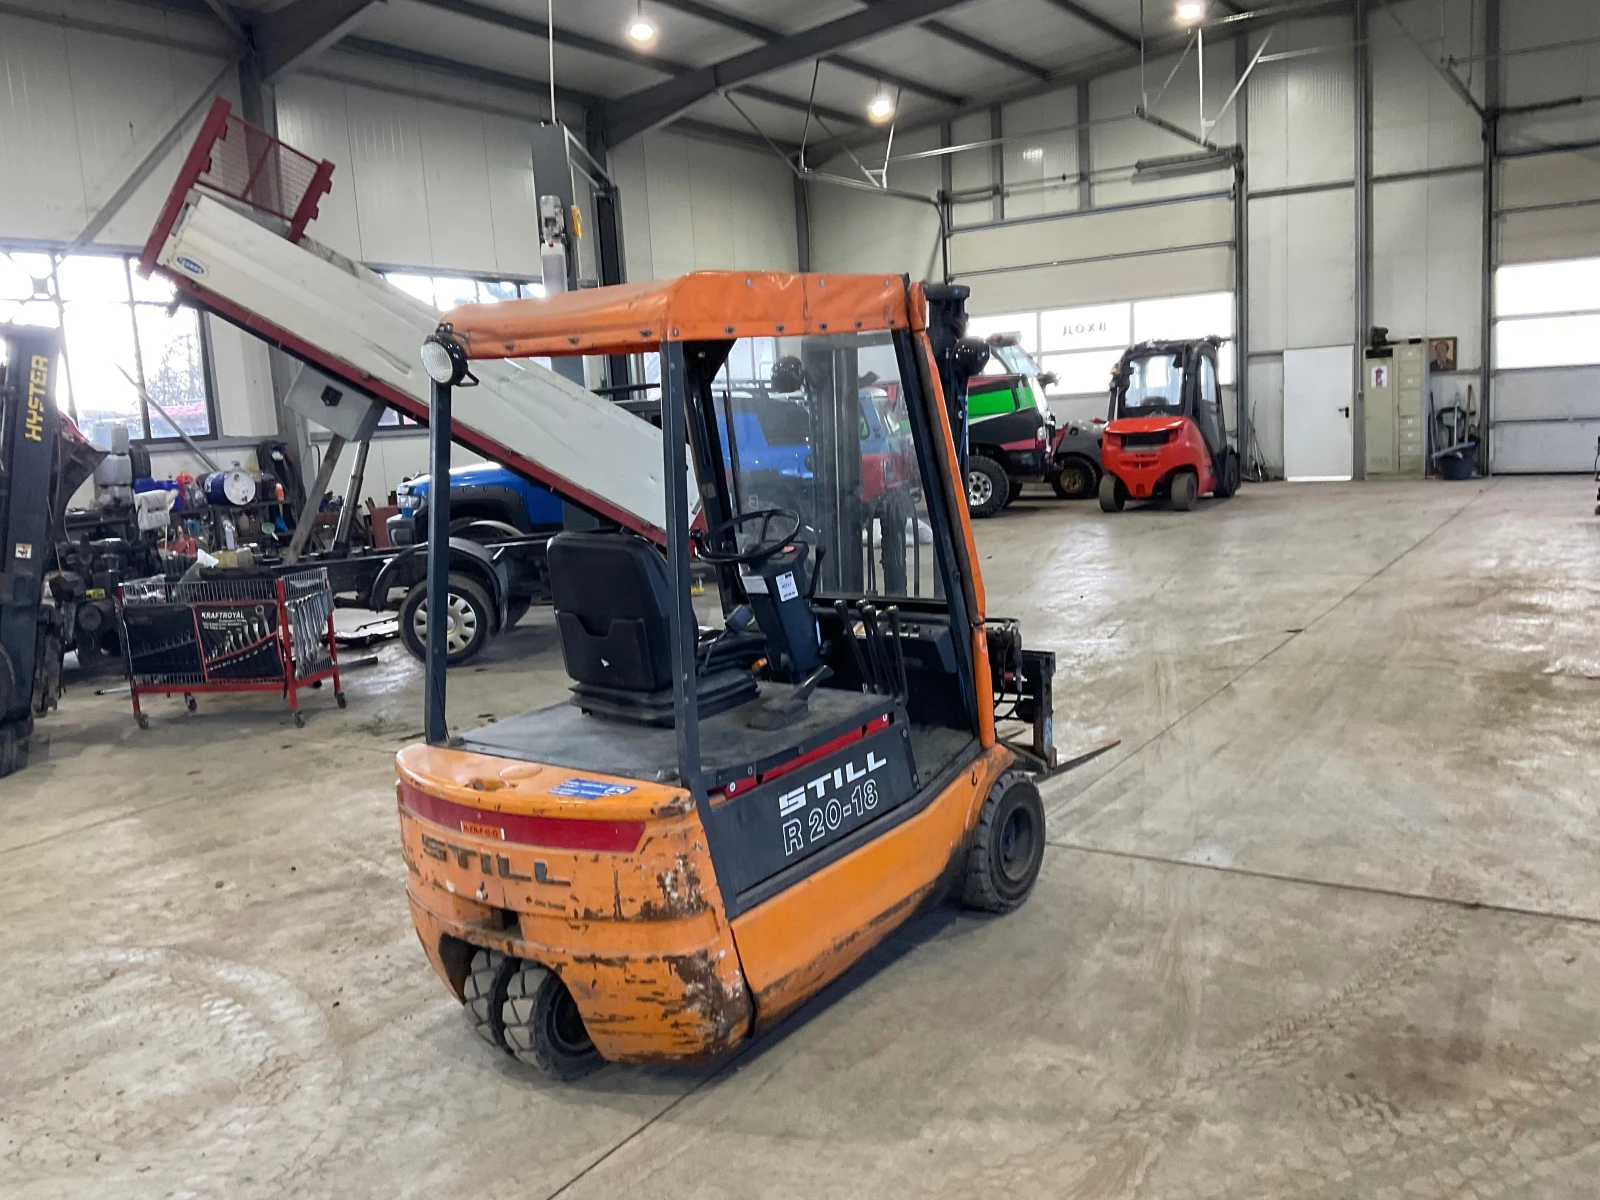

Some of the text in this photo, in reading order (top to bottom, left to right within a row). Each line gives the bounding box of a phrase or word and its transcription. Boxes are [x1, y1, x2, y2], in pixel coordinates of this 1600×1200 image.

[25, 355, 48, 441] HYSTER
[201, 611, 244, 619] KRAFTROYAL
[779, 751, 887, 817] STILL
[782, 779, 879, 856] R 20-18
[421, 833, 572, 887] STILL
